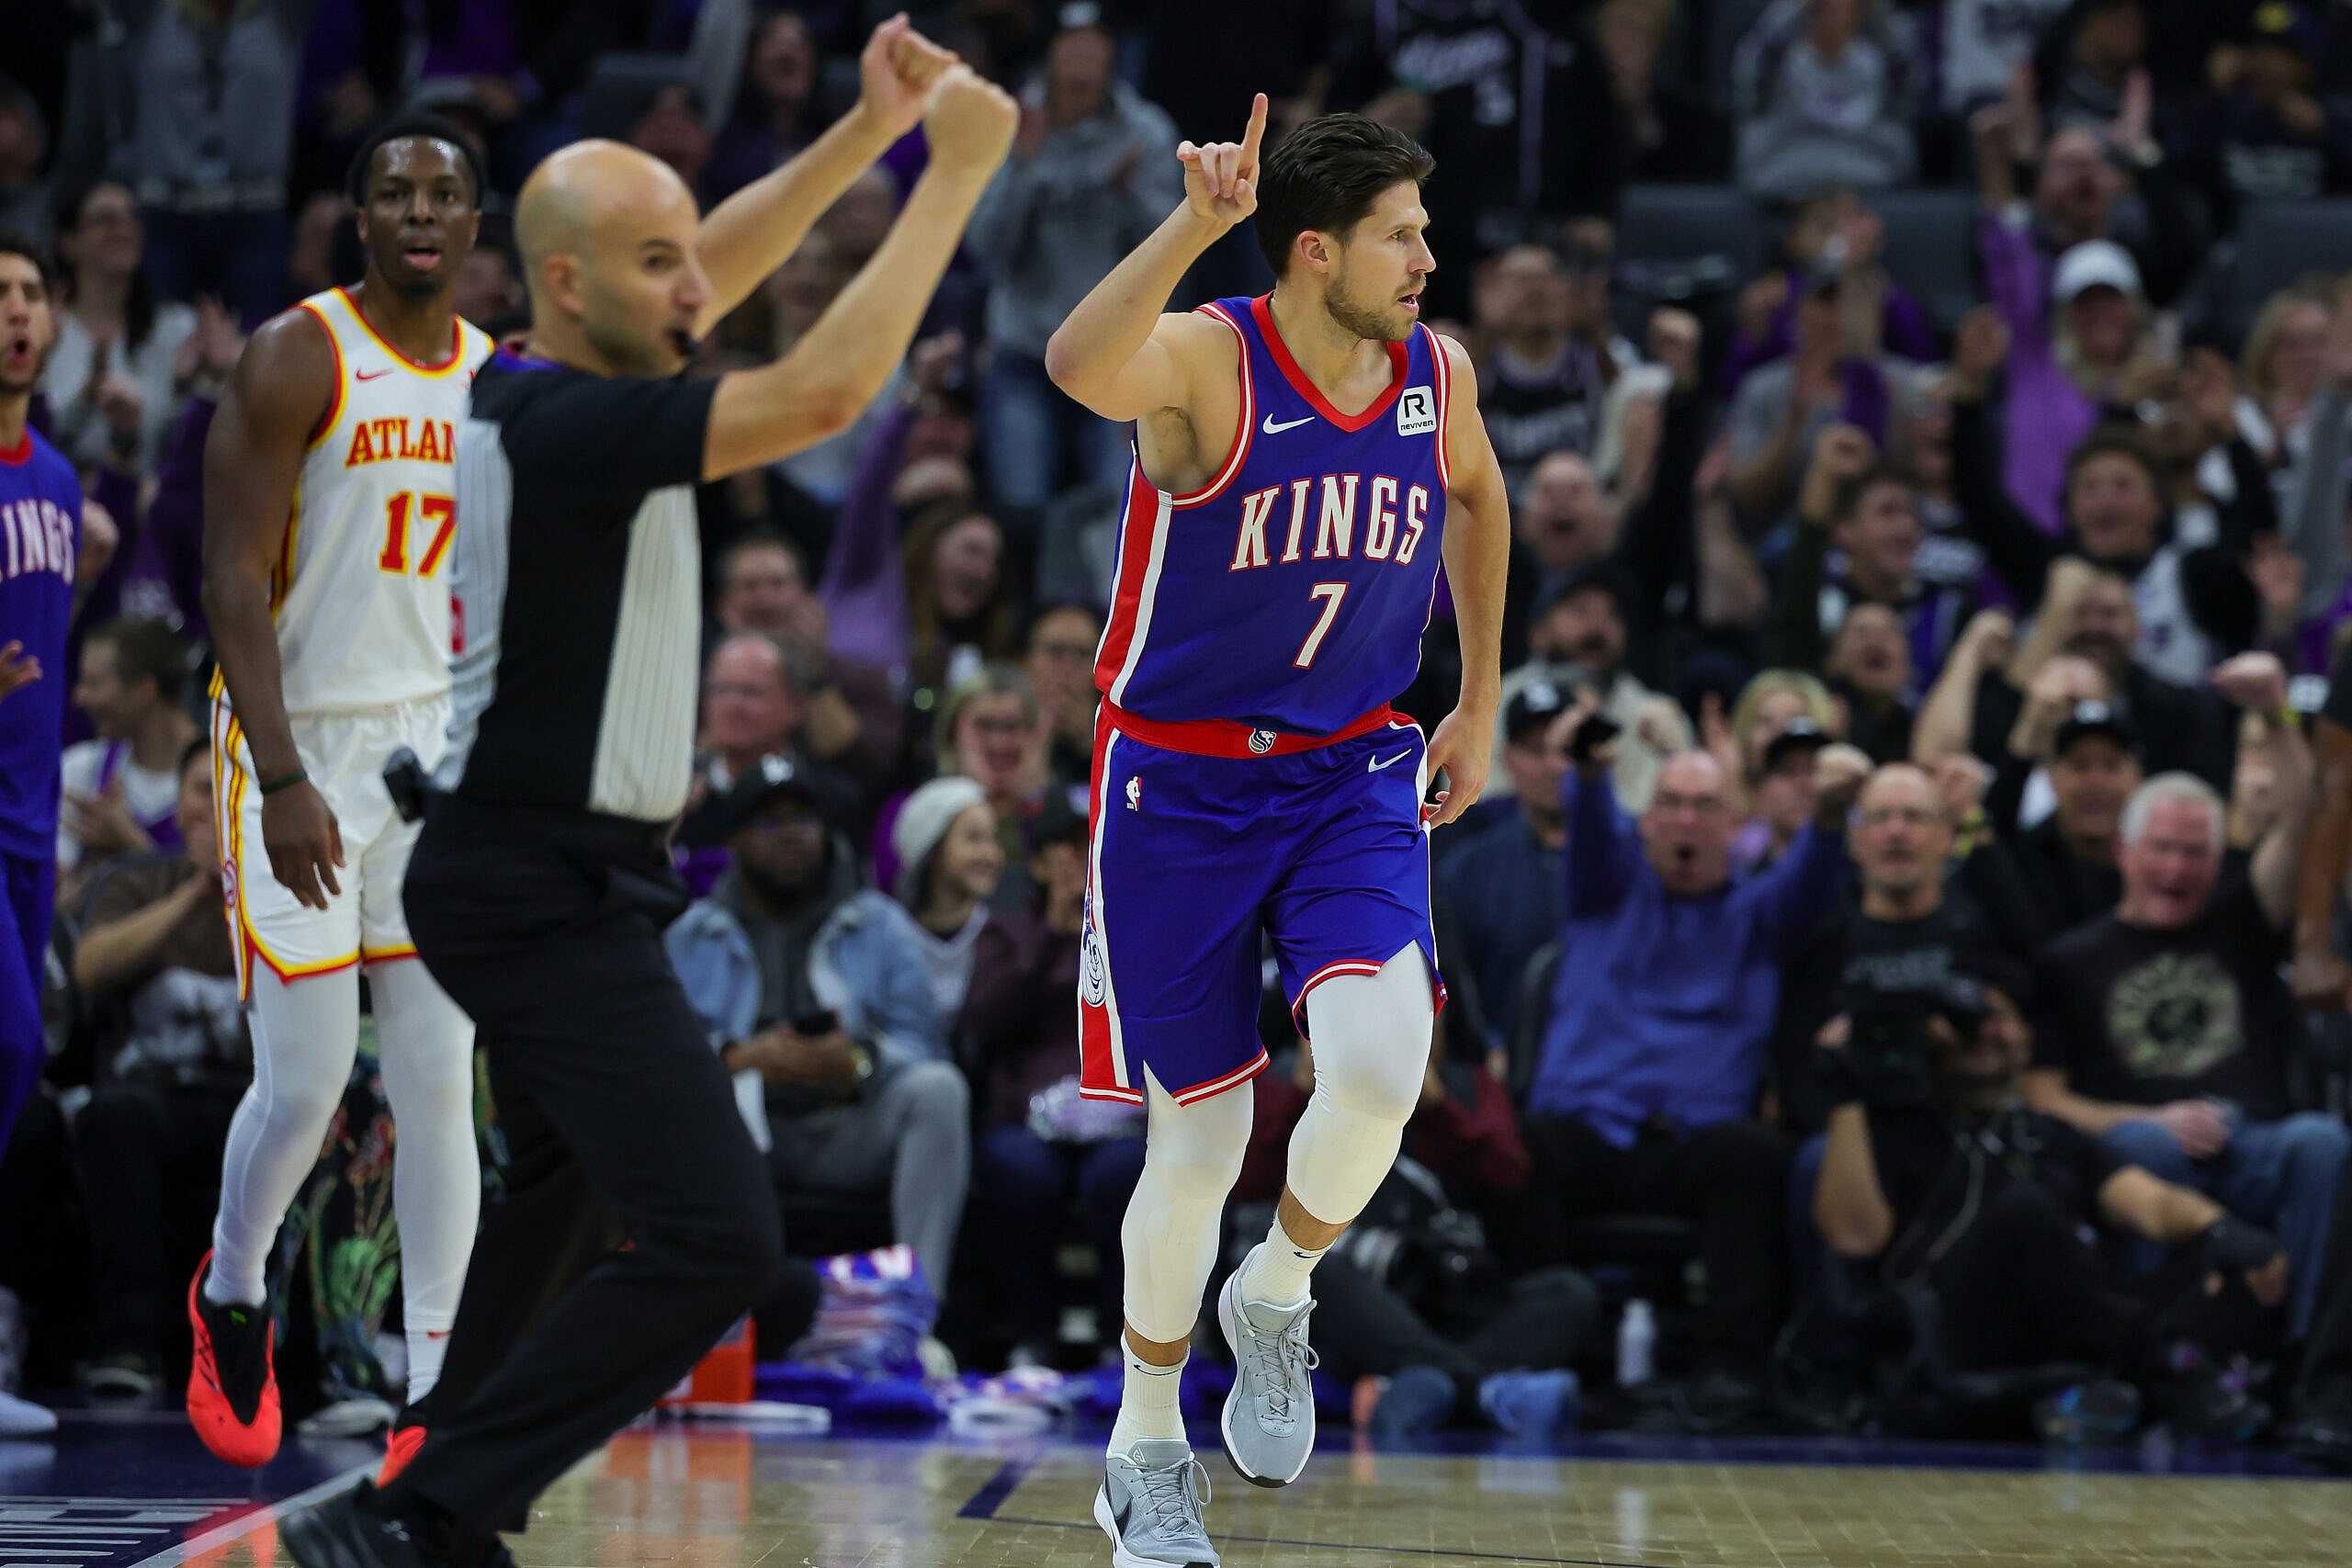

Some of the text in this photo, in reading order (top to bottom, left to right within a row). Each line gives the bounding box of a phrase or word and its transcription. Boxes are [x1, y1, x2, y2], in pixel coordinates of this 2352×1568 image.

[1400, 420, 1434, 431] REVIVER
[0, 499, 74, 586] INGS
[379, 491, 457, 578] 17
[1229, 473, 1429, 572] KINGS
[1293, 581, 1351, 670] 7
